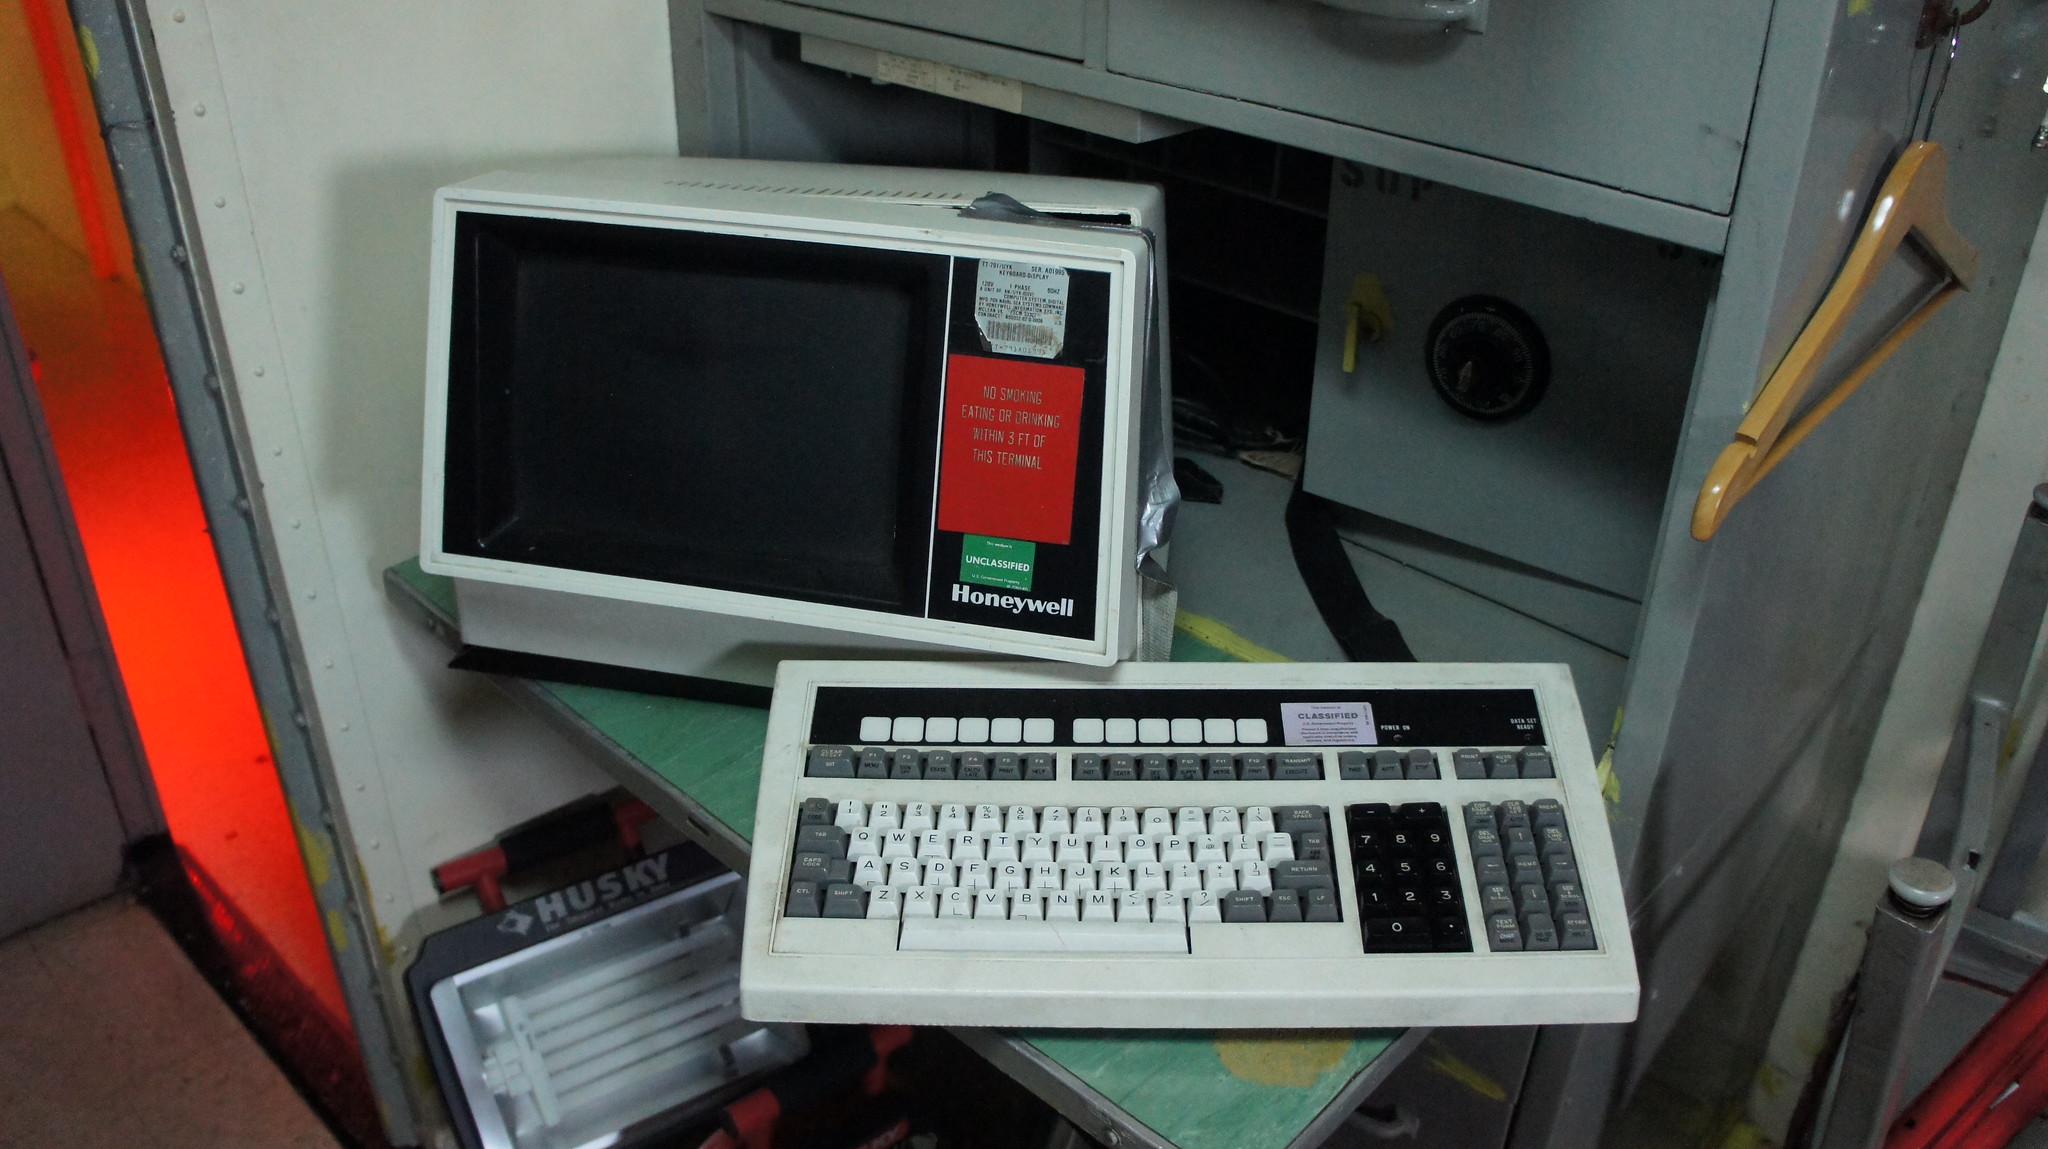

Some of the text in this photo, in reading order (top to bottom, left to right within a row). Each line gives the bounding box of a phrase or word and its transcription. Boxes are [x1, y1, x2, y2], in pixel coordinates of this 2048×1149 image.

[984, 386, 1043, 404] NO SMOKING
[962, 405, 1060, 428] EATING OR DRINKING
[973, 428, 1046, 448] WITHIN 3 FT OF
[973, 449, 1042, 470] THIS TERMINAL
[966, 555, 1030, 572] UNCLASSIFIED
[952, 584, 1074, 617] Honeywell
[859, 832, 868, 841] Q
[892, 833, 905, 842] W
[929, 834, 937, 843] E
[1033, 837, 1042, 846] Y
[1136, 839, 1145, 847] O
[1170, 840, 1179, 848] P
[1361, 834, 1440, 844] 7 8 9
[900, 862, 909, 870] S
[935, 863, 944, 872] D
[1076, 868, 1085, 876] J
[1365, 862, 1446, 873] 4 5 6
[535, 852, 669, 923] HUSKY
[879, 891, 888, 899] Z
[915, 891, 924, 899] X
[951, 892, 960, 901] C
[986, 894, 996, 902] V
[1022, 894, 1031, 902] B
[1371, 890, 1451, 902] 1 2 3
[1392, 922, 1402, 932] 0
